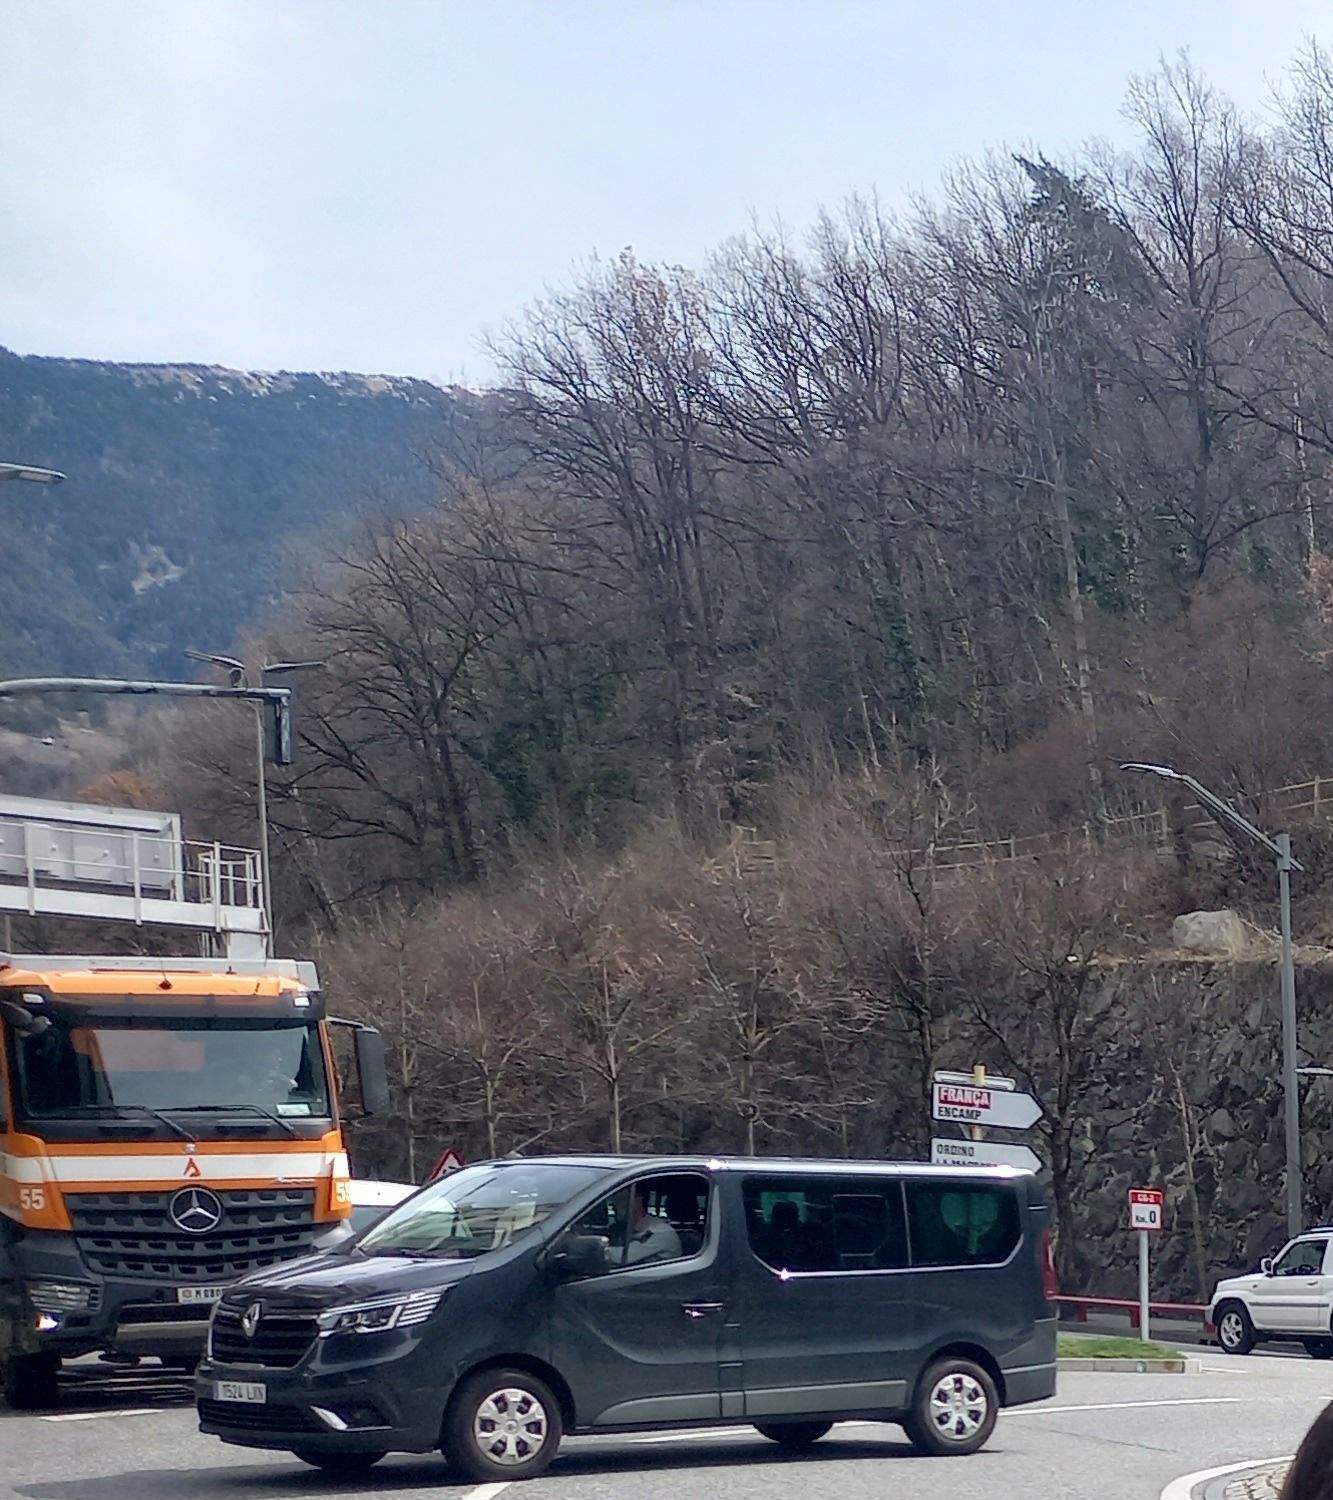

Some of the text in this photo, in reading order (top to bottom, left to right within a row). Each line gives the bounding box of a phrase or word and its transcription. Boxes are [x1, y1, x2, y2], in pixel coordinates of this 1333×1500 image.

[940, 1087, 990, 1106] FRANÇA
[938, 1106, 981, 1120] ENCAMP
[936, 1144, 975, 1157] ORDINO
[20, 1188, 45, 1210] 55
[1149, 1210, 1156, 1224] 0
